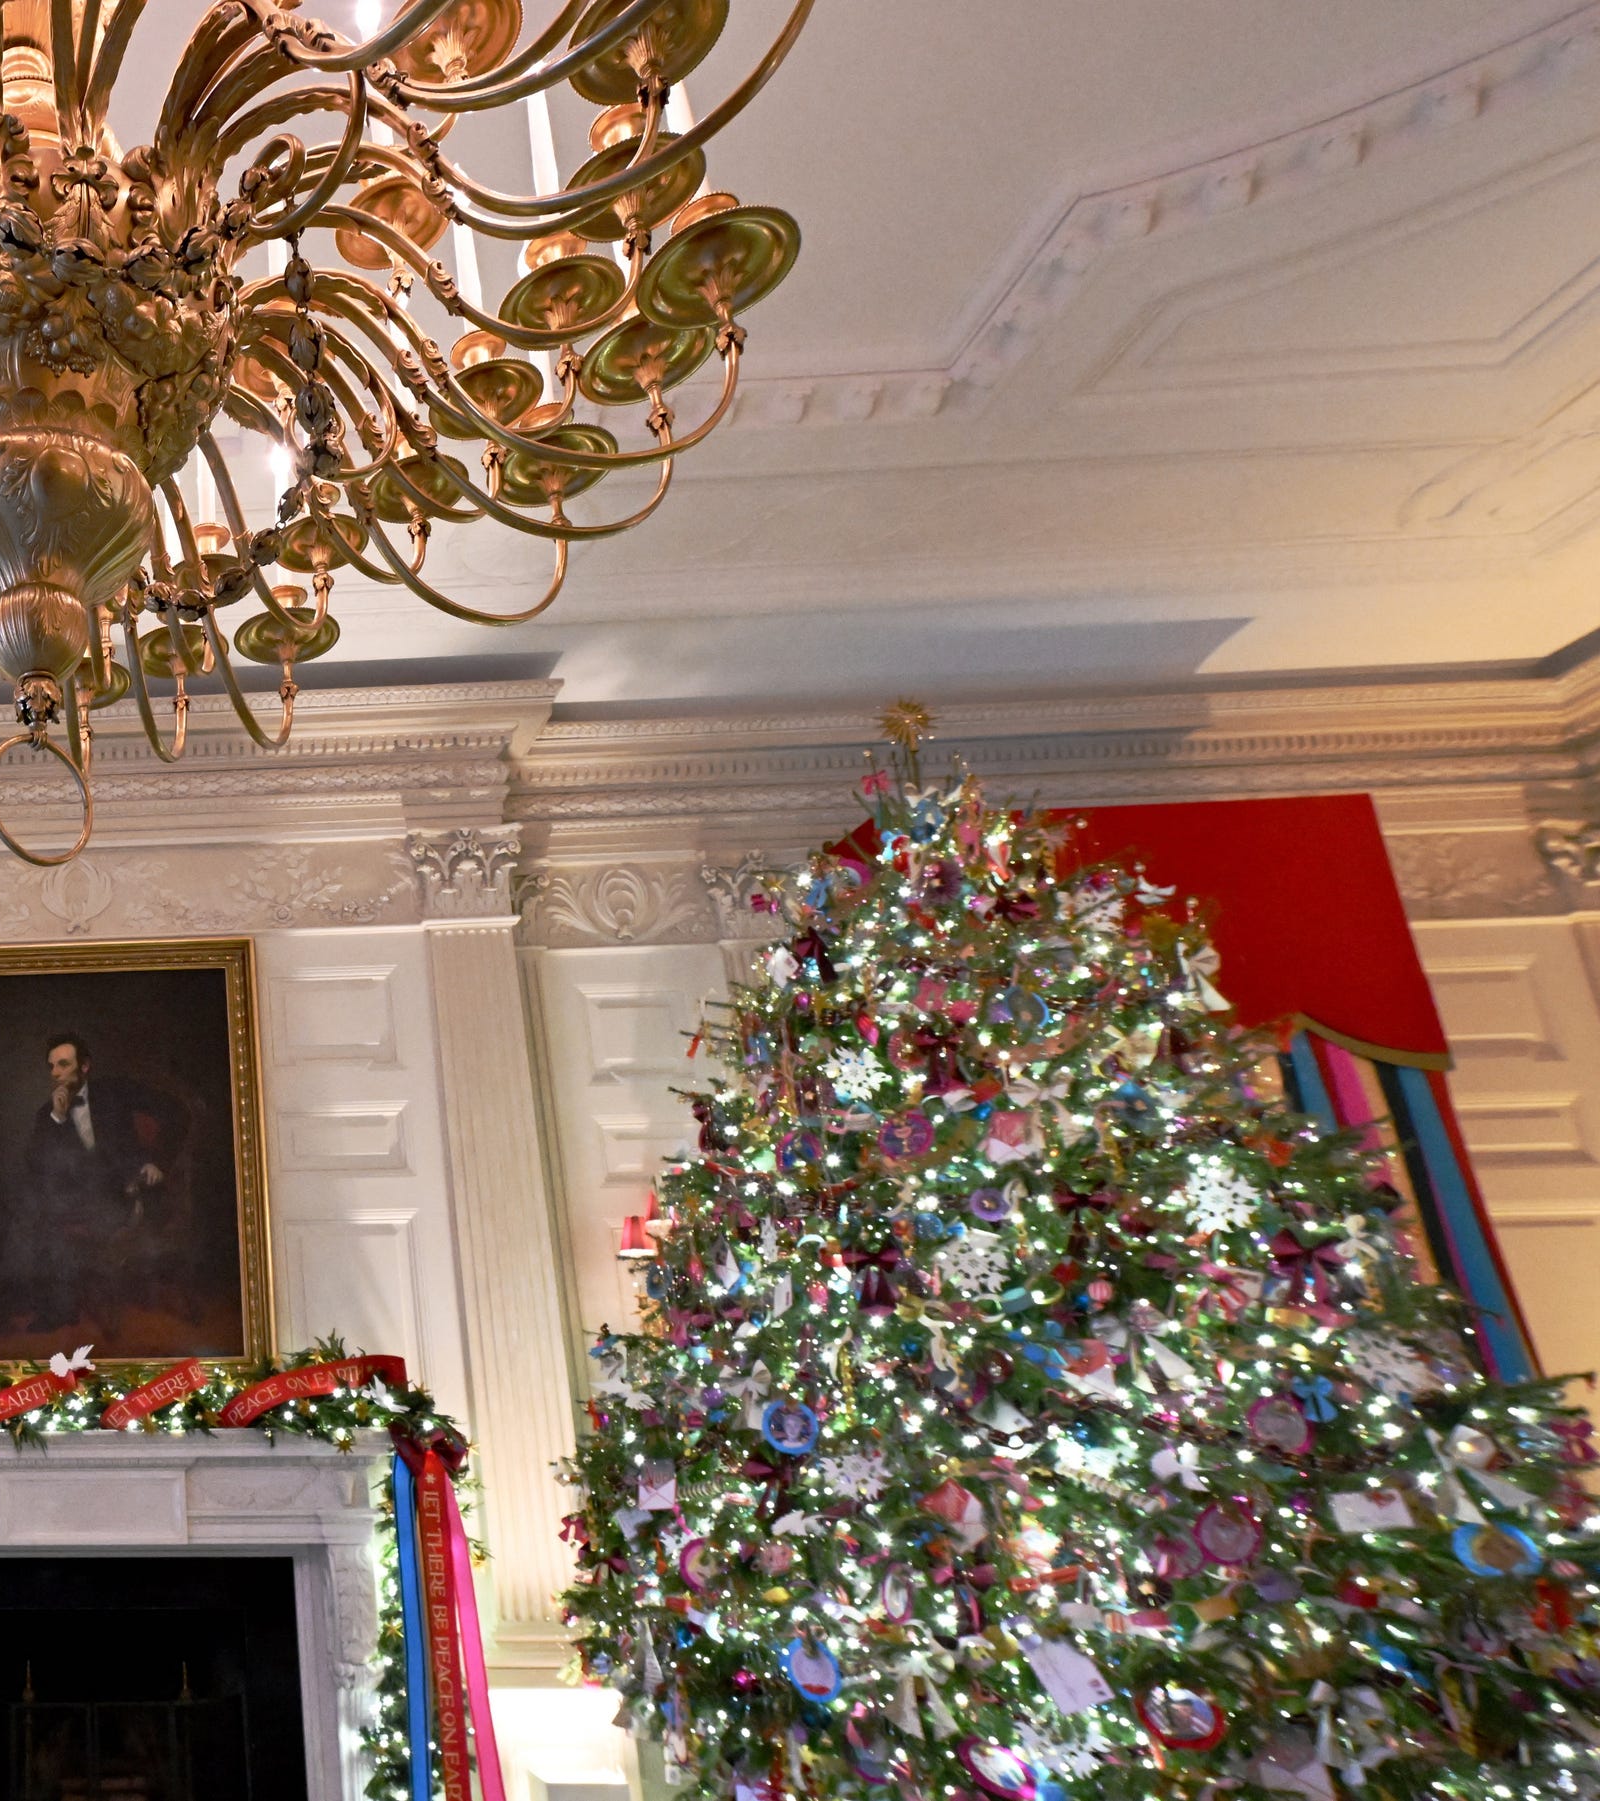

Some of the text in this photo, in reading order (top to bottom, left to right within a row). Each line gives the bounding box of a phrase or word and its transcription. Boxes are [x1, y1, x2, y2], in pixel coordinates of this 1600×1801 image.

[131, 1372, 190, 1408] THERE
[227, 1383, 282, 1426] PEACE
[286, 1375, 311, 1392] ON
[422, 1490, 441, 1523] LET
[426, 1528, 447, 1597] THERE
[432, 1604, 449, 1630] BE
[434, 1637, 454, 1708] PEACE
[441, 1712, 458, 1744] ON
